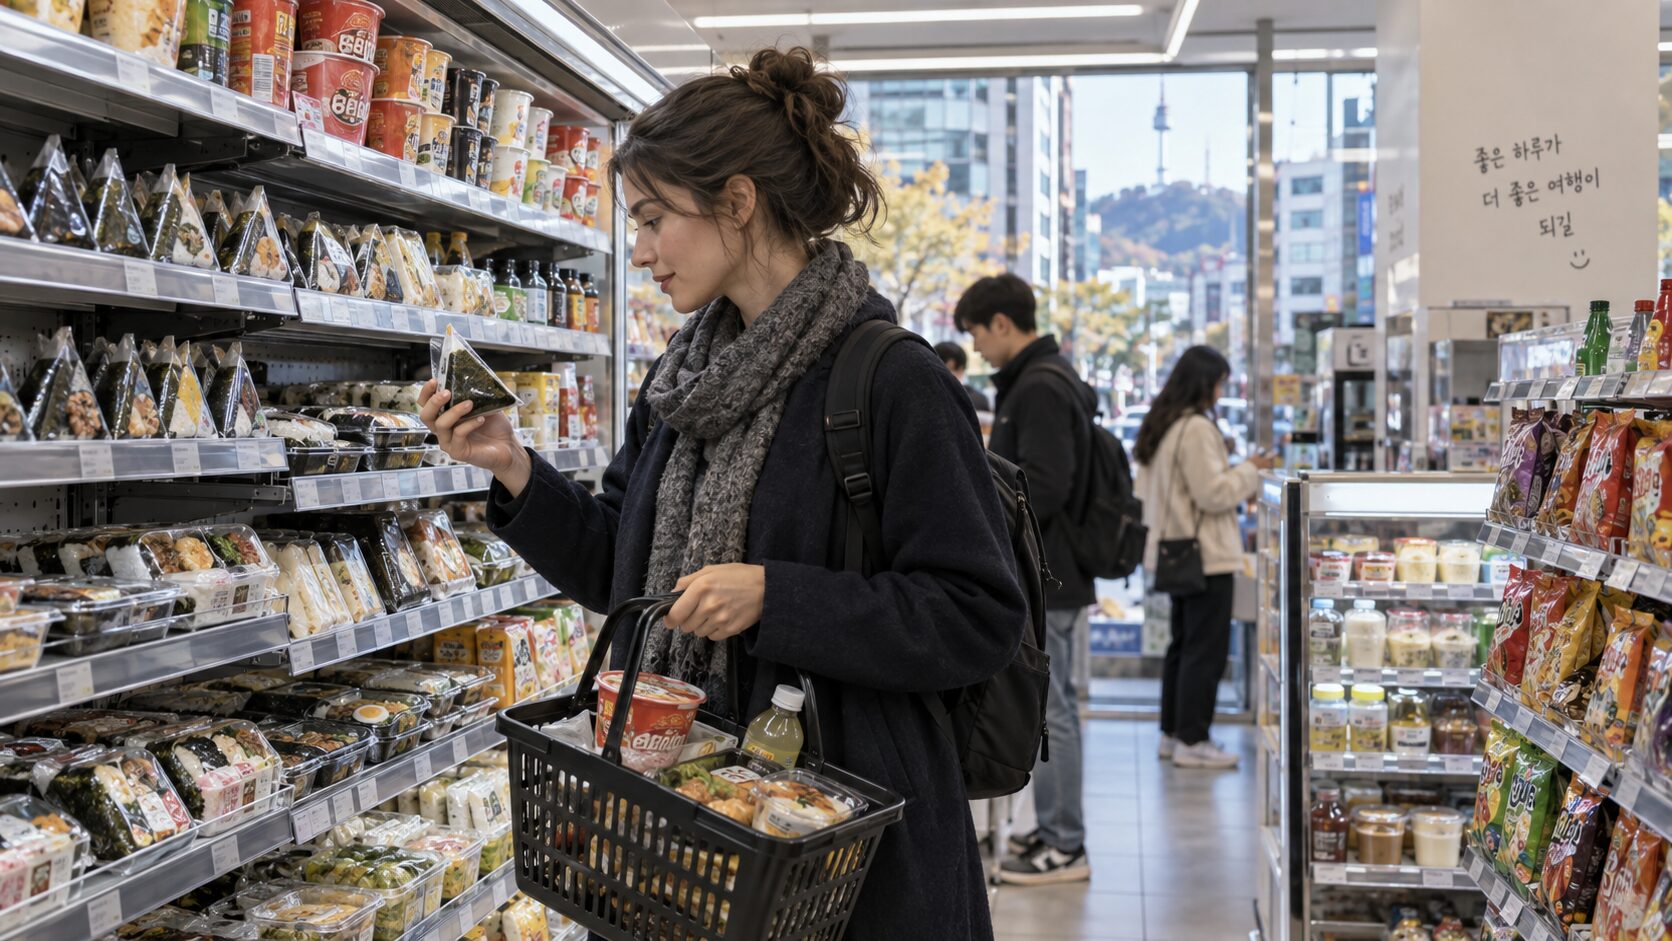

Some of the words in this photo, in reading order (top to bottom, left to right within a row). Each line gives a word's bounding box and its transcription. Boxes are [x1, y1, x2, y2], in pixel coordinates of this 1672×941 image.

[1474, 147, 1504, 174] 좋은
[1512, 133, 1562, 161] 하루가
[1483, 187, 1499, 208] 더
[1508, 181, 1539, 207] 좋은
[1548, 167, 1599, 194] 여행이
[1539, 211, 1575, 237] 되길
